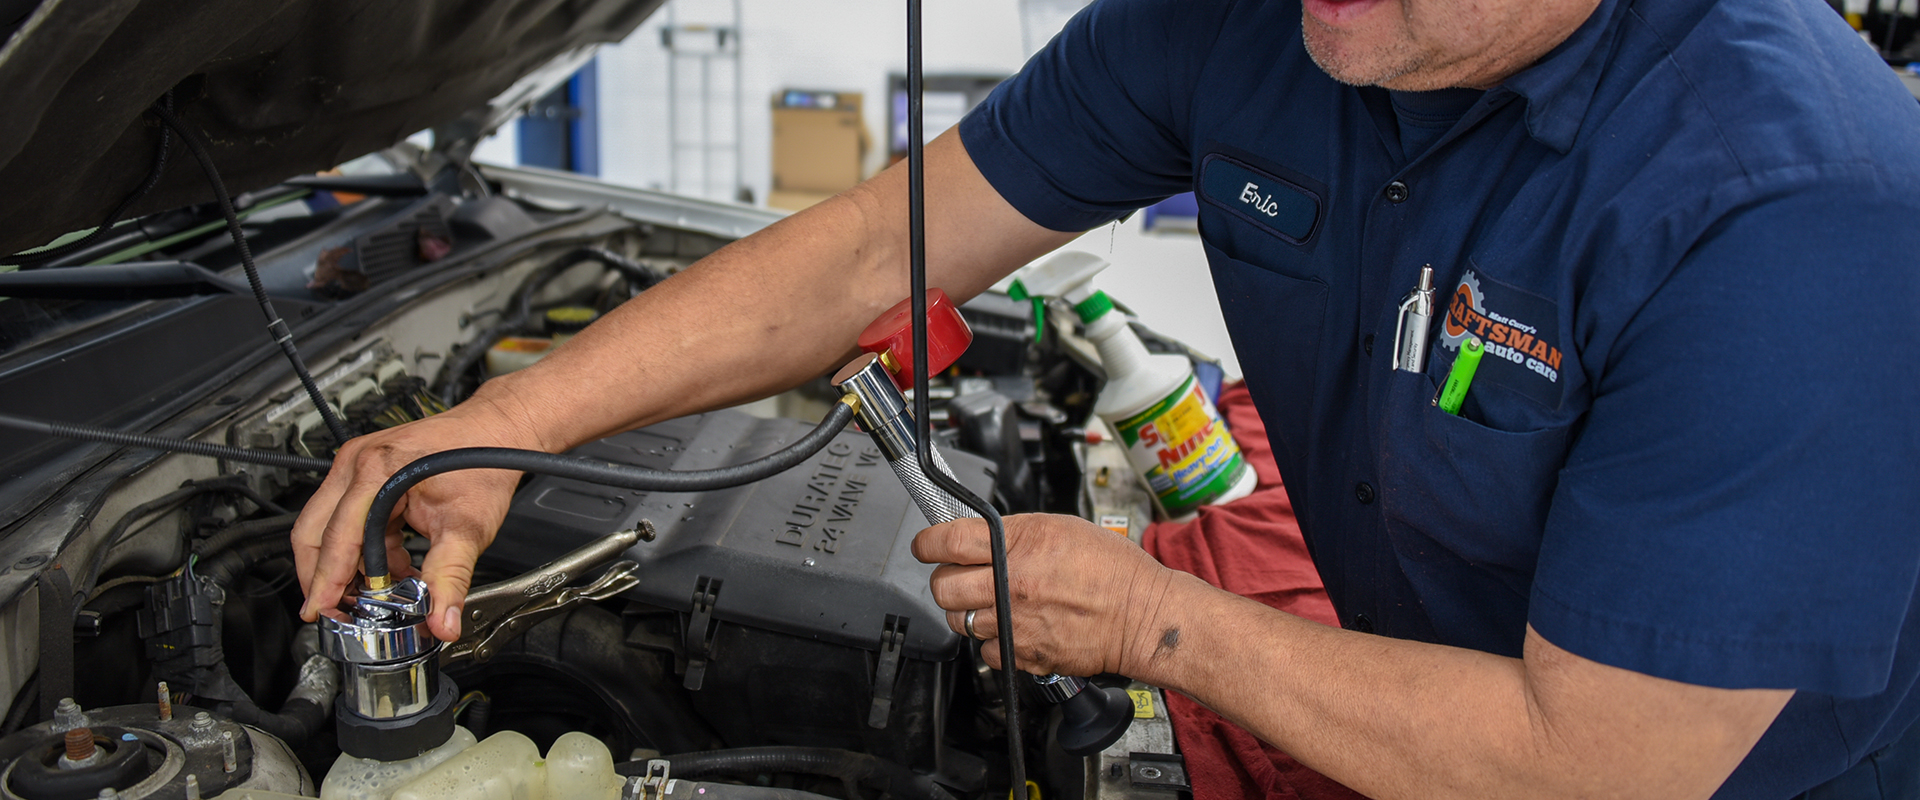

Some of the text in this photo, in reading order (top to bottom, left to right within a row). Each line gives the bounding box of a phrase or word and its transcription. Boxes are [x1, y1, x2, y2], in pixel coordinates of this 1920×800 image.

[1239, 182, 1278, 217] Eric
[1488, 311, 1537, 334] Matt Curry's
[1484, 341, 1558, 382] auto care
[775, 442, 853, 548] DURATEC
[813, 446, 881, 555] 24 VALVE V6
